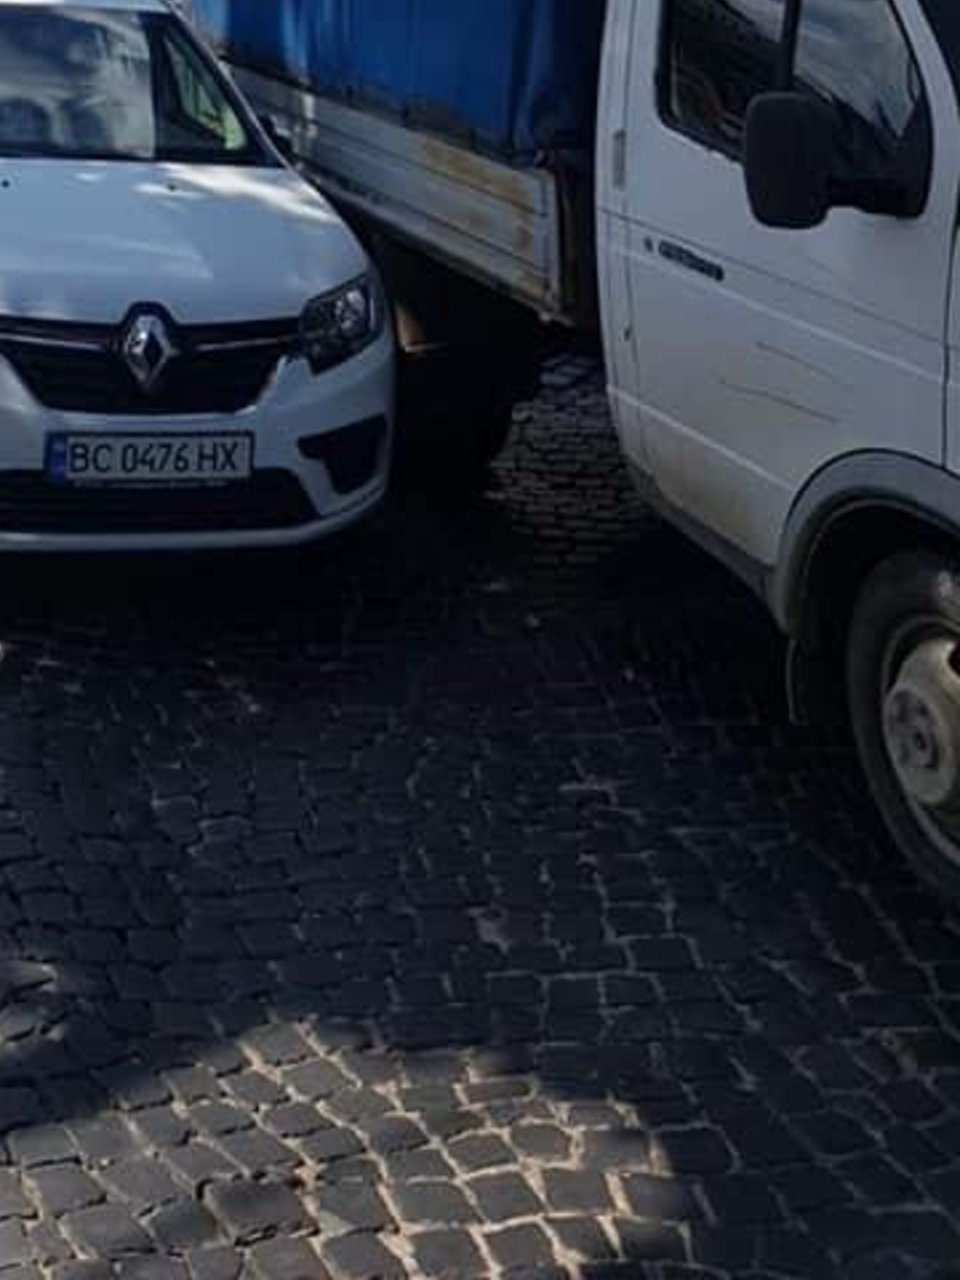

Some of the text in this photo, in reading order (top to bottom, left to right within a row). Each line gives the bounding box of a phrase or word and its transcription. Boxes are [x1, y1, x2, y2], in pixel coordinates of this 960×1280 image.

[69, 440, 239, 473] BC 0476 HX
